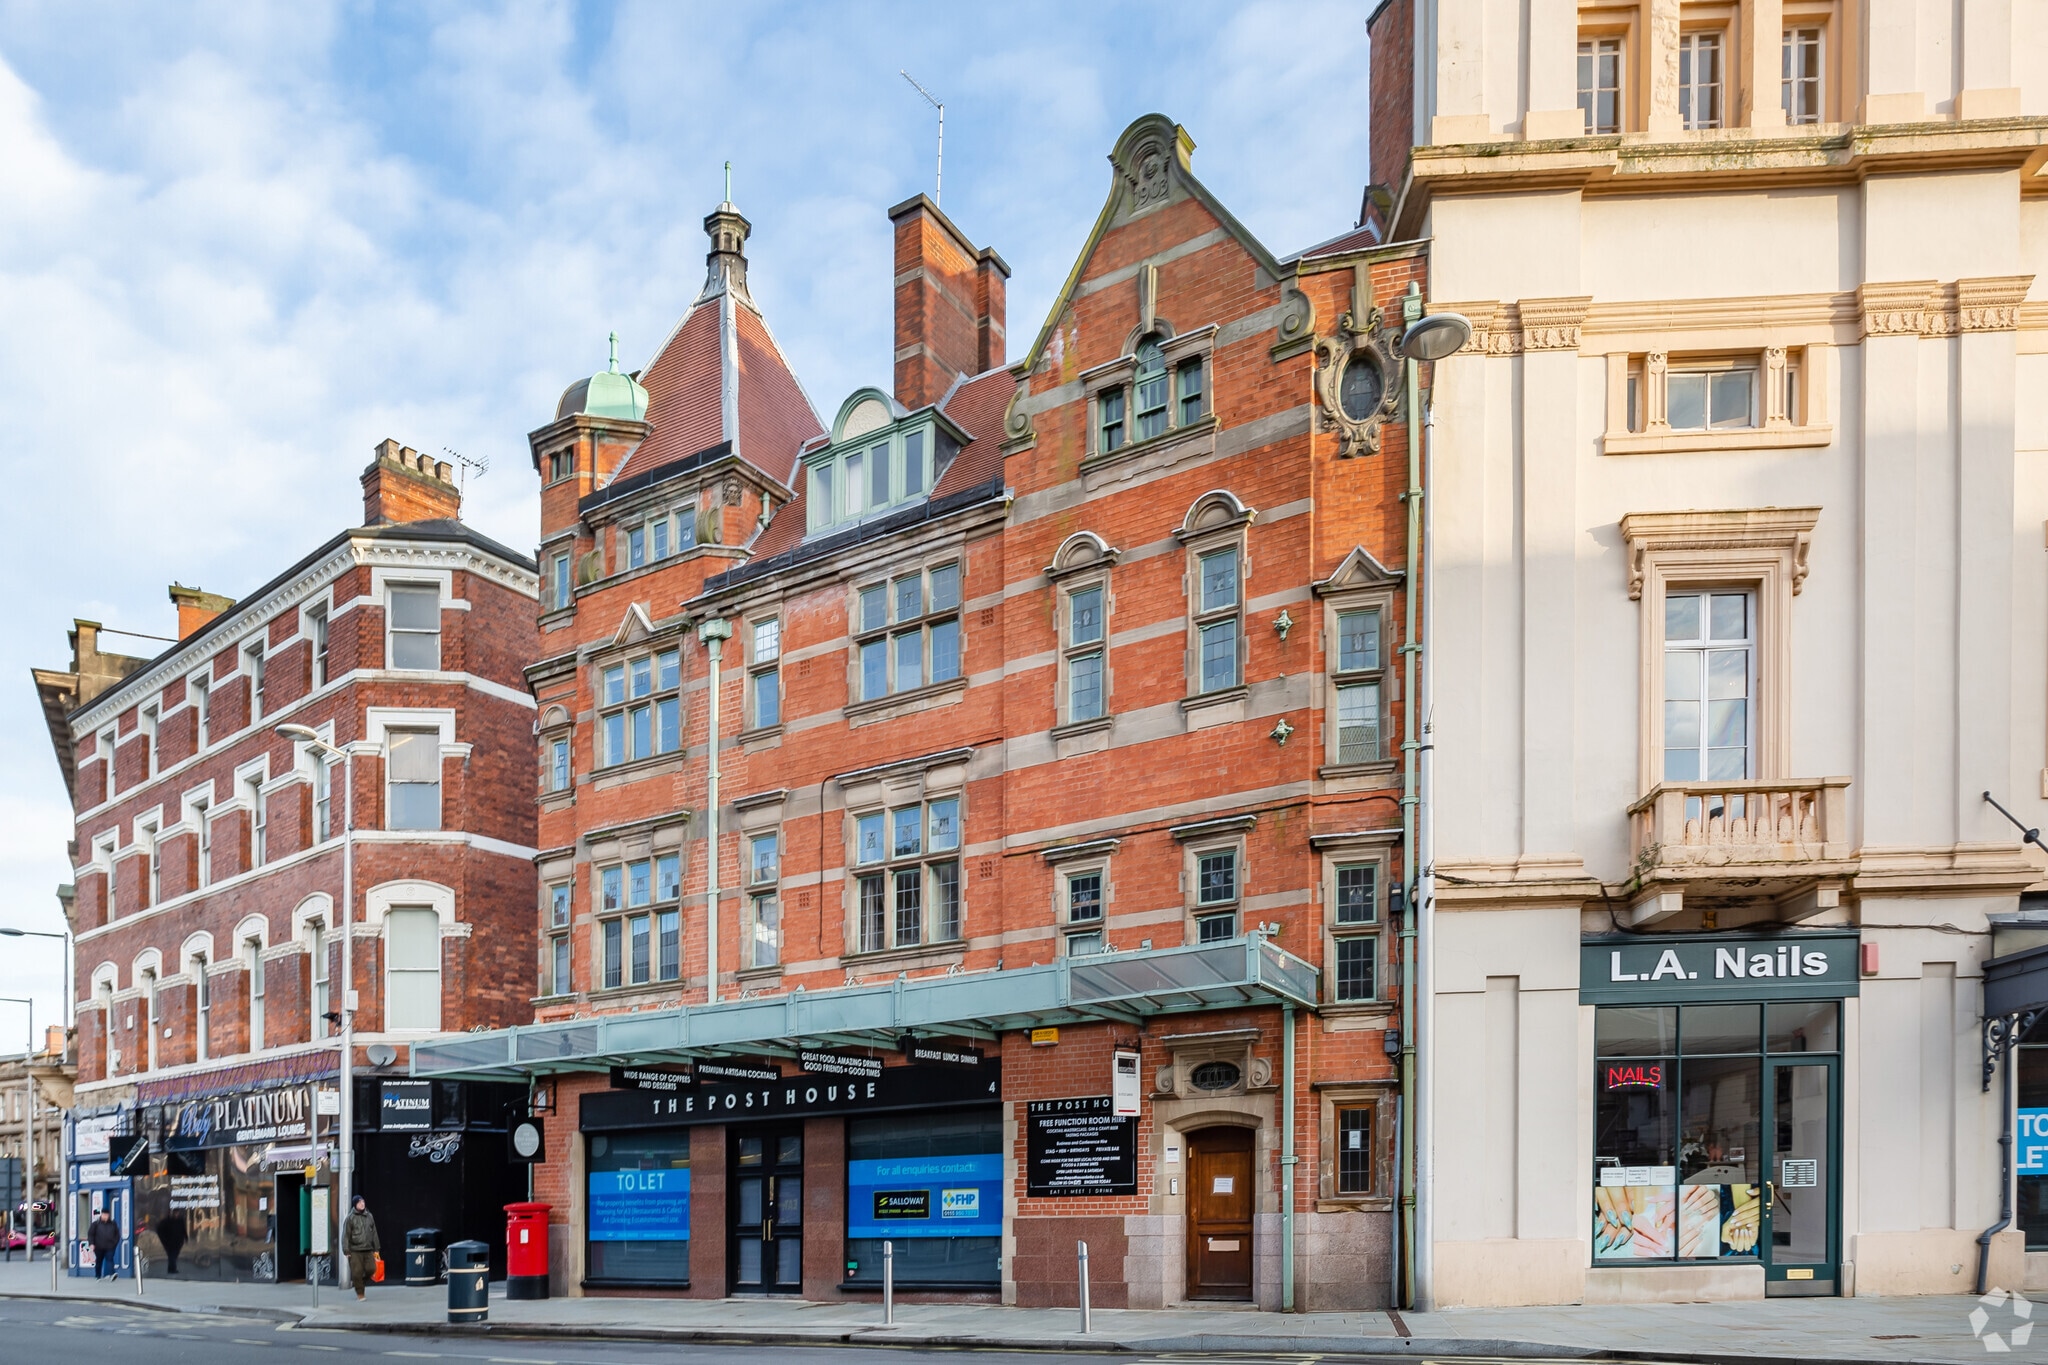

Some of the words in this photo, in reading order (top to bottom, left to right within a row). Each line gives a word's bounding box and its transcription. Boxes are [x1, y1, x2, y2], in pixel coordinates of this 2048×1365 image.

[1611, 950, 1698, 982] L.A.
[1715, 946, 1829, 979] Nails
[801, 1052, 819, 1062] GREAT
[837, 1057, 862, 1067] AMAZING
[915, 1049, 941, 1060] BREAKFAST
[943, 1052, 959, 1063] LUNCH
[960, 1055, 978, 1064] DINNER
[624, 1071, 638, 1079] WIDE
[639, 1072, 658, 1080] RANGE
[660, 1073, 667, 1081] OF
[667, 1074, 691, 1084] COFFEES
[699, 1065, 724, 1075] PREMIUM
[724, 1067, 747, 1077] ARTISAN
[748, 1069, 777, 1080] COCKTAILS
[804, 1062, 822, 1072] GOOD
[823, 1064, 843, 1074] FRIENDS
[848, 1067, 866, 1076] GOOD
[866, 1068, 880, 1078] TIMES
[1609, 1066, 1660, 1084] NAILS
[639, 1080, 651, 1089] AND
[652, 1082, 677, 1090] DESSERTS
[989, 1081, 996, 1093] 4
[383, 1099, 429, 1108] PLATINUM
[653, 1097, 694, 1114] THE
[708, 1091, 770, 1110] POST
[786, 1082, 875, 1105] HOUSE
[214, 1088, 304, 1131] PLATINUM
[1031, 1102, 1051, 1112] THE
[1058, 1100, 1087, 1110] POST
[1055, 1118, 1087, 1126] FUNCTION
[1089, 1116, 1110, 1124] ROOM
[236, 1126, 276, 1142] GENTLEMANS
[278, 1123, 305, 1136] LOUNGE
[877, 1166, 890, 1176] For
[891, 1165, 900, 1175] all
[902, 1164, 939, 1176] enquiries
[617, 1174, 635, 1191] TO
[640, 1173, 665, 1190] LET
[889, 1197, 924, 1206] SALLOWAY
[956, 1194, 975, 1205] FHP
